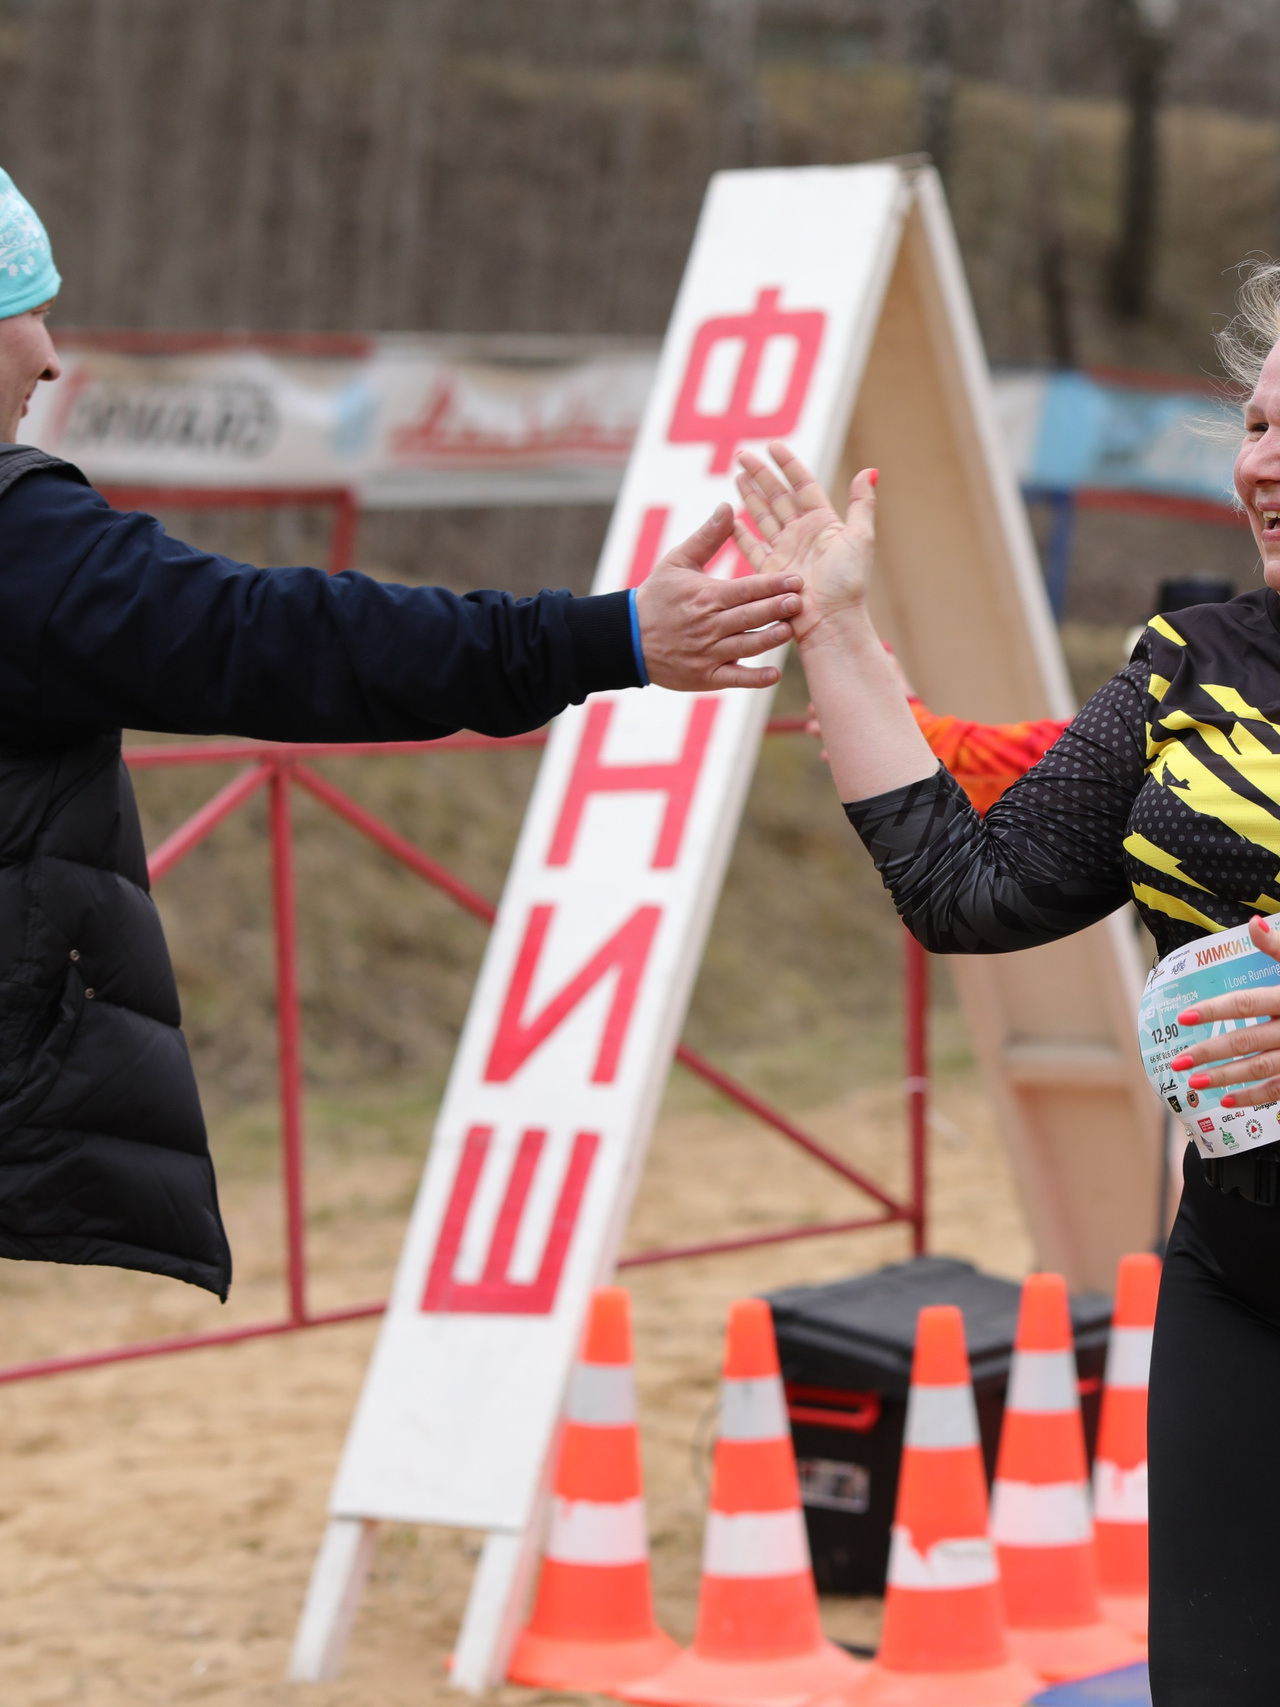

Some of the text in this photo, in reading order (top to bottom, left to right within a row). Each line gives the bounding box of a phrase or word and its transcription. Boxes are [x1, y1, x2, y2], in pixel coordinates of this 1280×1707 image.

[1229, 974, 1248, 988] Love
[1182, 991, 1199, 1004] 2024
[1159, 1003, 1182, 1014] TRAIL
[1151, 1023, 1179, 1044] 12,90
